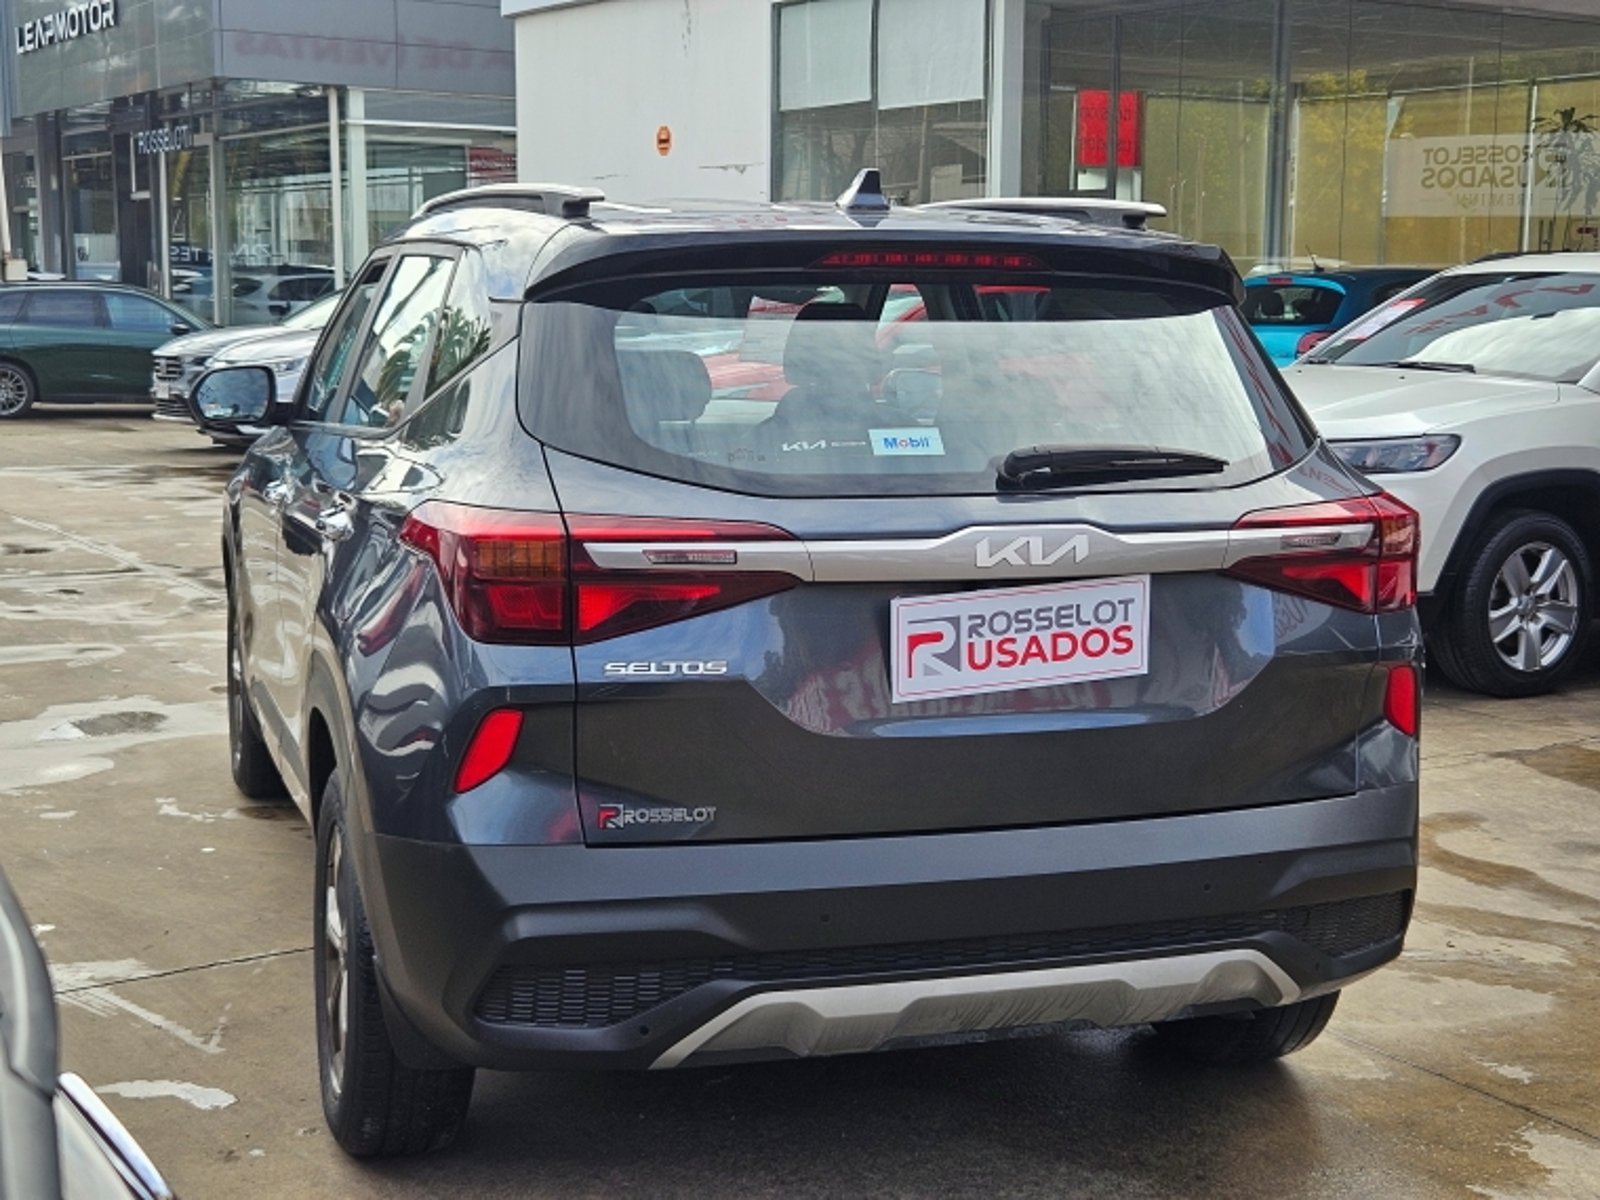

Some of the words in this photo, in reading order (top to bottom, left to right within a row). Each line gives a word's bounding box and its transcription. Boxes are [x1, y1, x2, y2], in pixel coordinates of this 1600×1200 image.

[14, 0, 115, 54] LEAPMOTOR
[138, 125, 189, 154] ROSSELOT
[883, 436, 929, 449] Mobil
[976, 534, 1089, 568] KIA
[967, 598, 1135, 639] ROSSELOT
[967, 625, 1134, 672] USADOS
[604, 660, 728, 676] SELTOS
[624, 806, 717, 824] ROSSELOT
